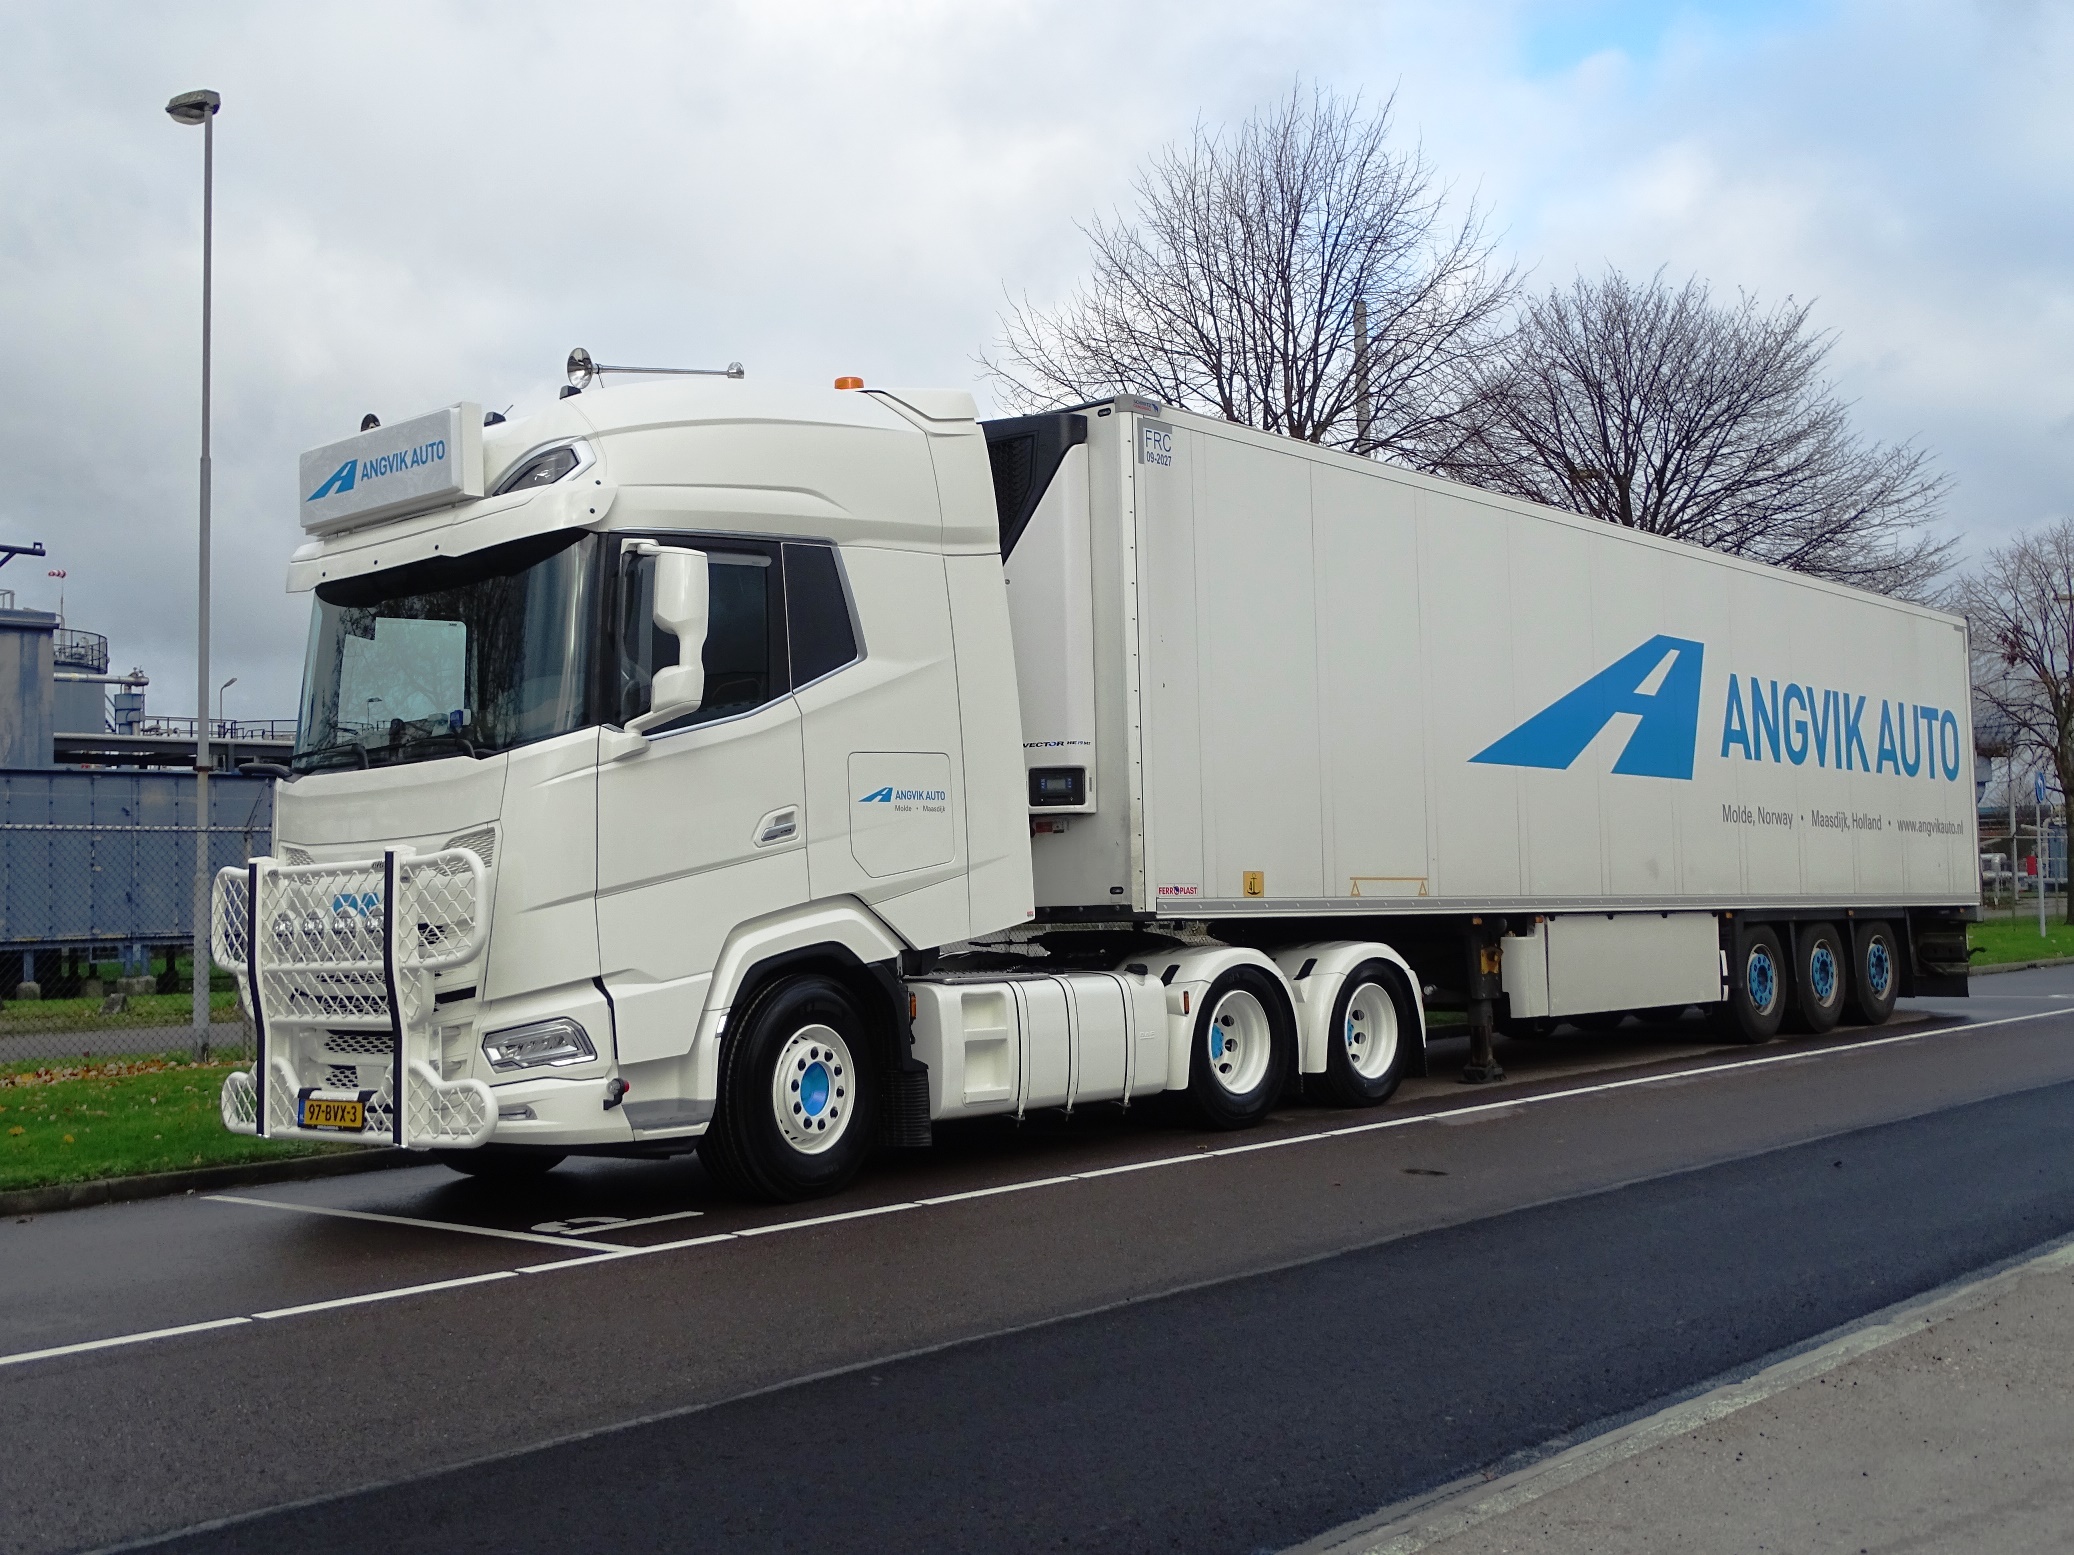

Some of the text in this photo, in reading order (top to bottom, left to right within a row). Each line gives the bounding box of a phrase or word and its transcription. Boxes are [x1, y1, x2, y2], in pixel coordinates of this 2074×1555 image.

[1145, 429, 1172, 452] FRC
[361, 439, 446, 482] ANGVIK AUTO
[1146, 451, 1172, 466] 09-2027
[1720, 673, 1960, 782] ANGVIK AUTO
[895, 790, 946, 801] ANGVIK AUTO
[923, 805, 946, 814] Maasdijk
[1722, 804, 1964, 837] Molde, Norway Maasdijk, Holland www.angvikauto.nl
[1158, 886, 1198, 896] FERROPLAST
[308, 1103, 357, 1122] 97-BVX-3
